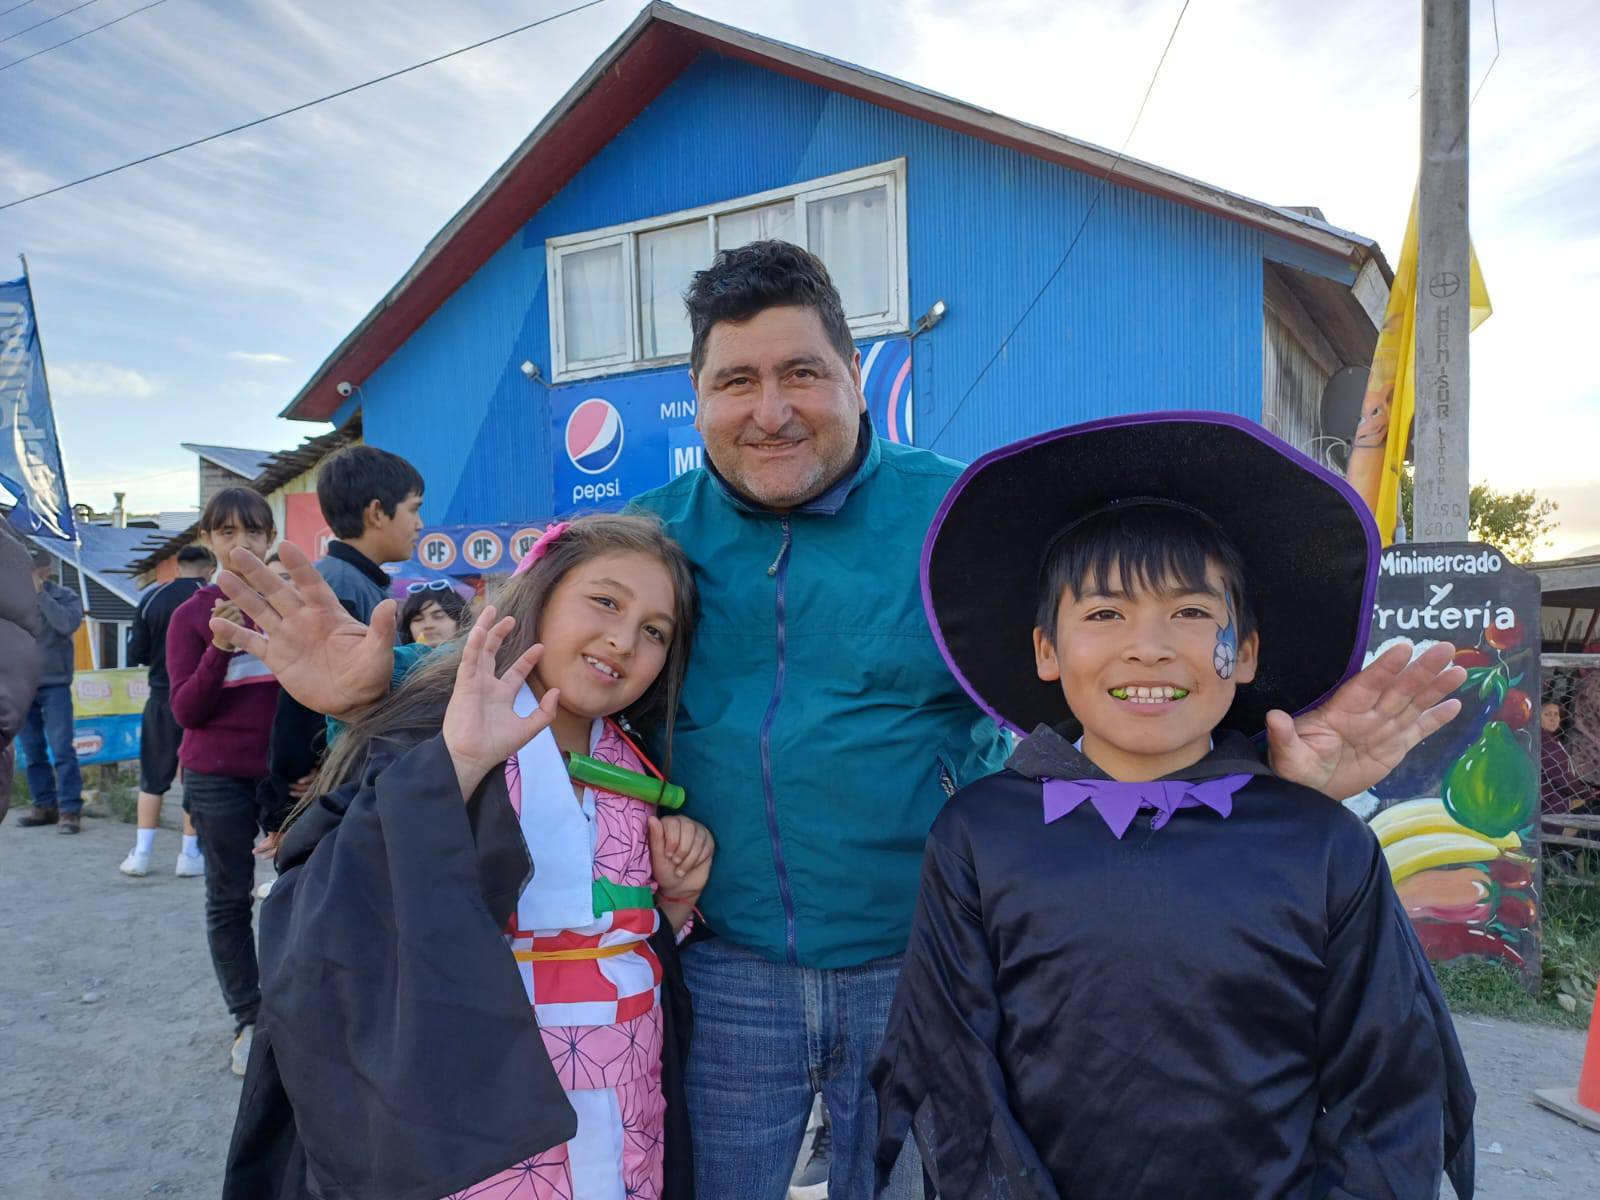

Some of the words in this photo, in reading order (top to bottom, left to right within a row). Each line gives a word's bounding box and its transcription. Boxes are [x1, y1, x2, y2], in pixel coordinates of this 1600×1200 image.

[573, 477, 621, 505] pepsi
[427, 541, 446, 561] PF
[473, 538, 492, 561] PF
[1379, 550, 1502, 577] Minimercado
